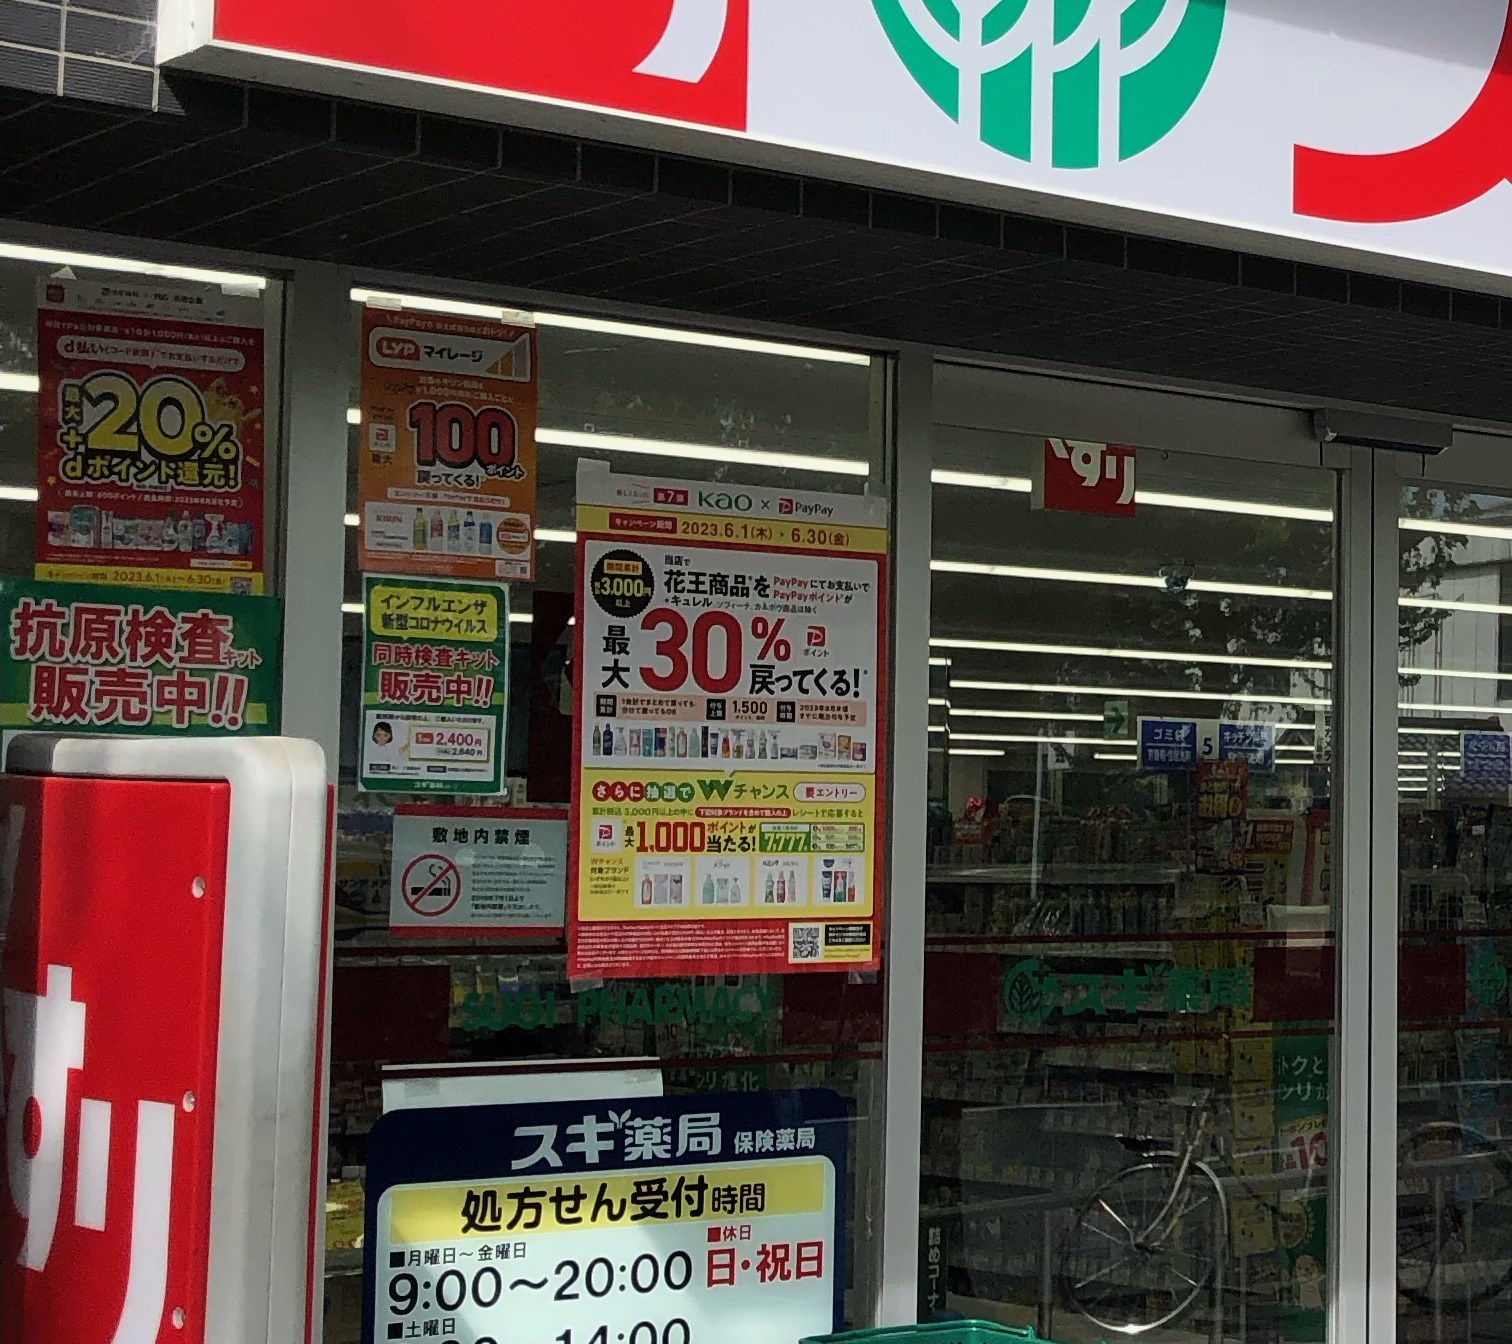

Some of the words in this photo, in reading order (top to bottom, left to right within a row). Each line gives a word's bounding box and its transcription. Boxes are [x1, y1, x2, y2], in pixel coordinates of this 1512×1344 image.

[423, 346, 484, 362] マイレージ
[410, 400, 516, 467] 100
[795, 502, 834, 518] PayPay
[681, 520, 773, 541] 2023.6.1(木)
[791, 528, 850, 547] 6.30(金)
[381, 593, 488, 616] インフルエンザ
[381, 612, 488, 634] 新型コロナウイルス
[373, 643, 499, 670] 同時検査キット
[639, 607, 792, 694] 30%
[380, 669, 494, 707] 販売中!!
[748, 662, 861, 699] 戻ってくる!
[32, 667, 249, 727] 販売中!!
[732, 700, 768, 715] 1,500
[436, 732, 482, 747] 2,400円
[1202, 737, 1213, 755] 5
[432, 827, 531, 846] 敷地内禁煙
[636, 821, 706, 853] 1,000
[511, 1109, 723, 1171] スギ薬局
[734, 1126, 816, 1155] 保険薬局
[461, 1174, 767, 1235] 処方せん受付時間
[722, 1224, 752, 1241] 休日
[388, 1250, 694, 1317] 9:00〜20:00
[404, 1317, 457, 1338] 土曜日
